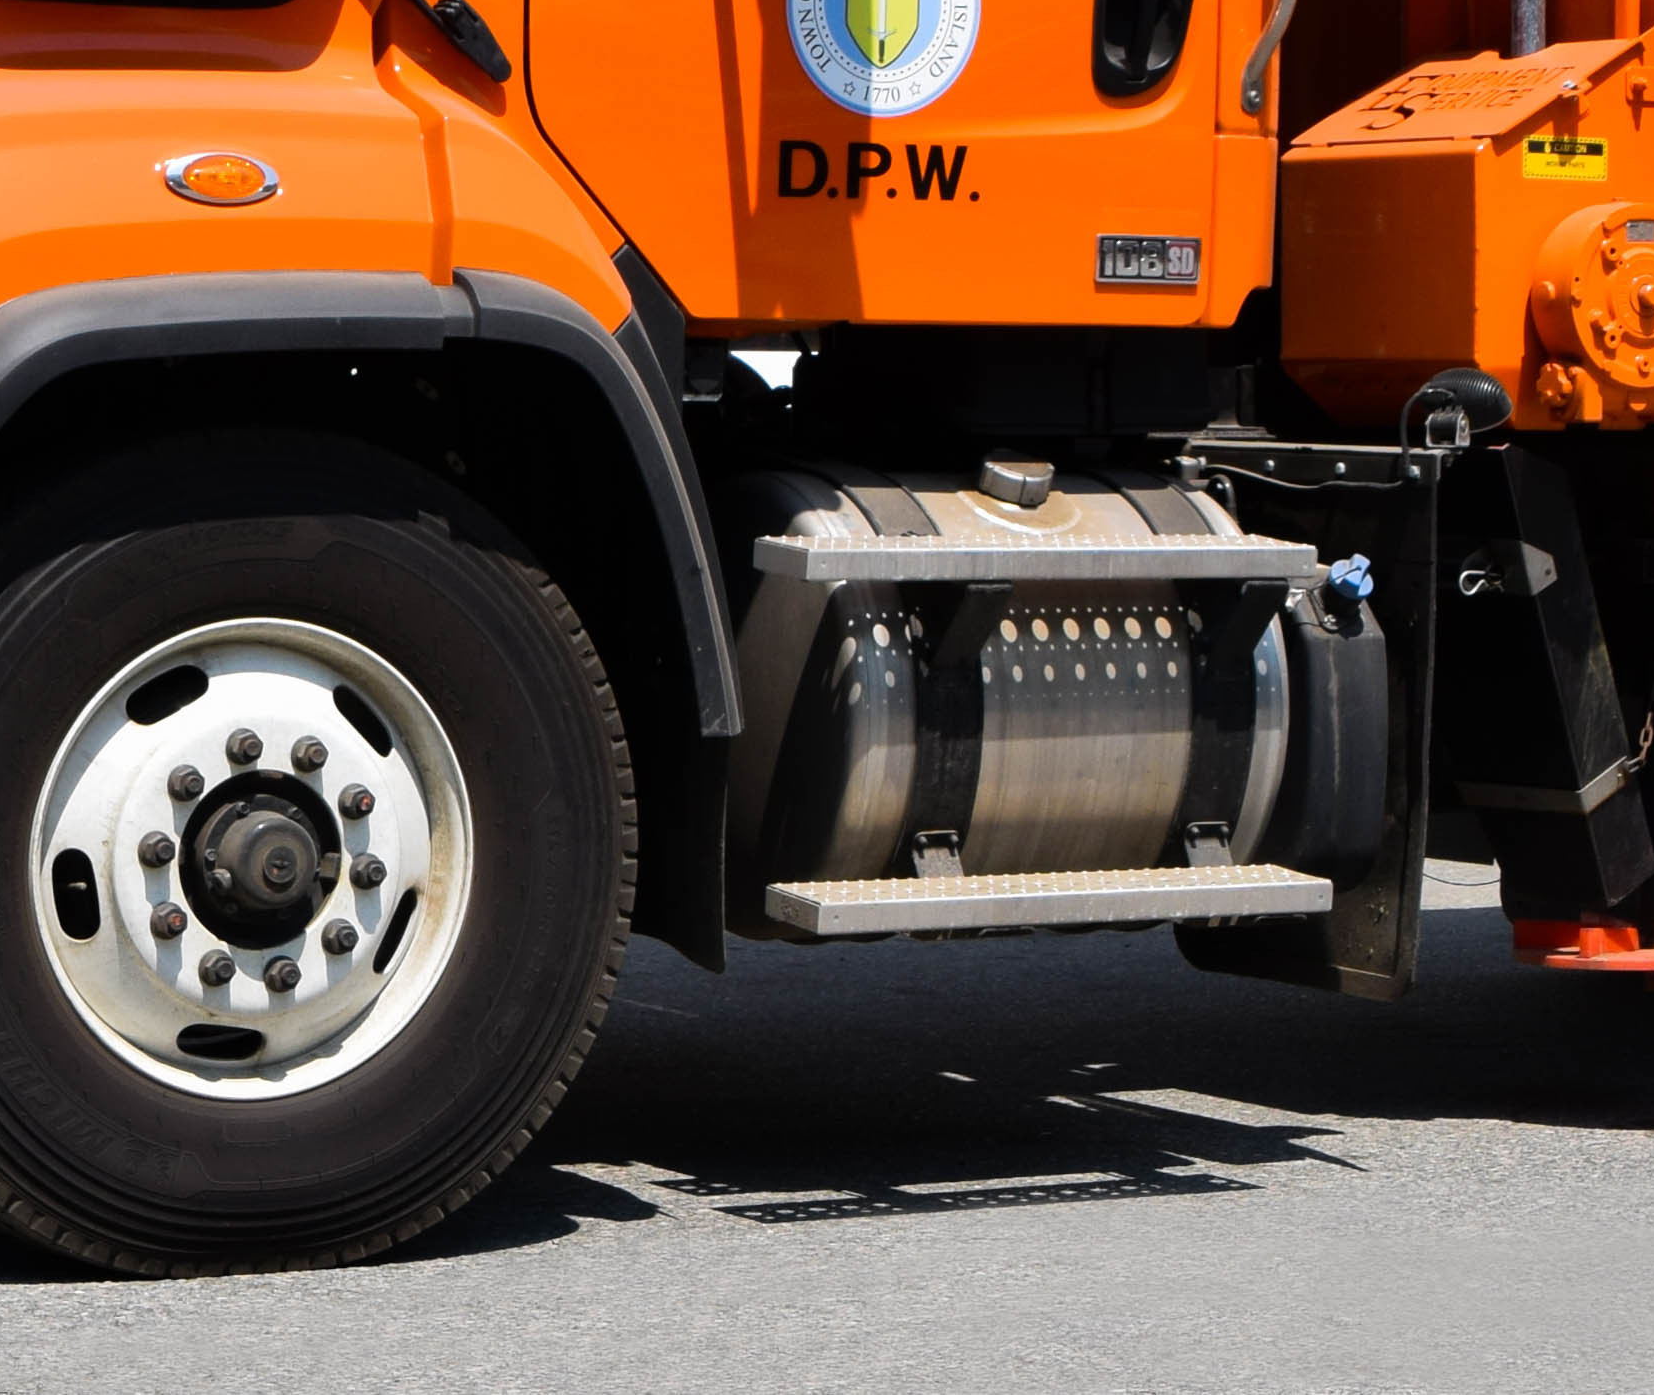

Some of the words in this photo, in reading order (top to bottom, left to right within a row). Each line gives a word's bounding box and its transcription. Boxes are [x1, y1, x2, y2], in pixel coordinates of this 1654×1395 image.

[798, 7, 831, 74] TOWN
[929, 4, 969, 78] ISLAND
[863, 87, 901, 103] 1770
[1357, 88, 1534, 130] SERVICE
[1358, 66, 1575, 112] EQUIPMENT
[1553, 143, 1587, 154] CAUTION
[777, 139, 981, 202] D.P.W.
[1103, 240, 1163, 277] 108
[1169, 246, 1195, 275] SD
